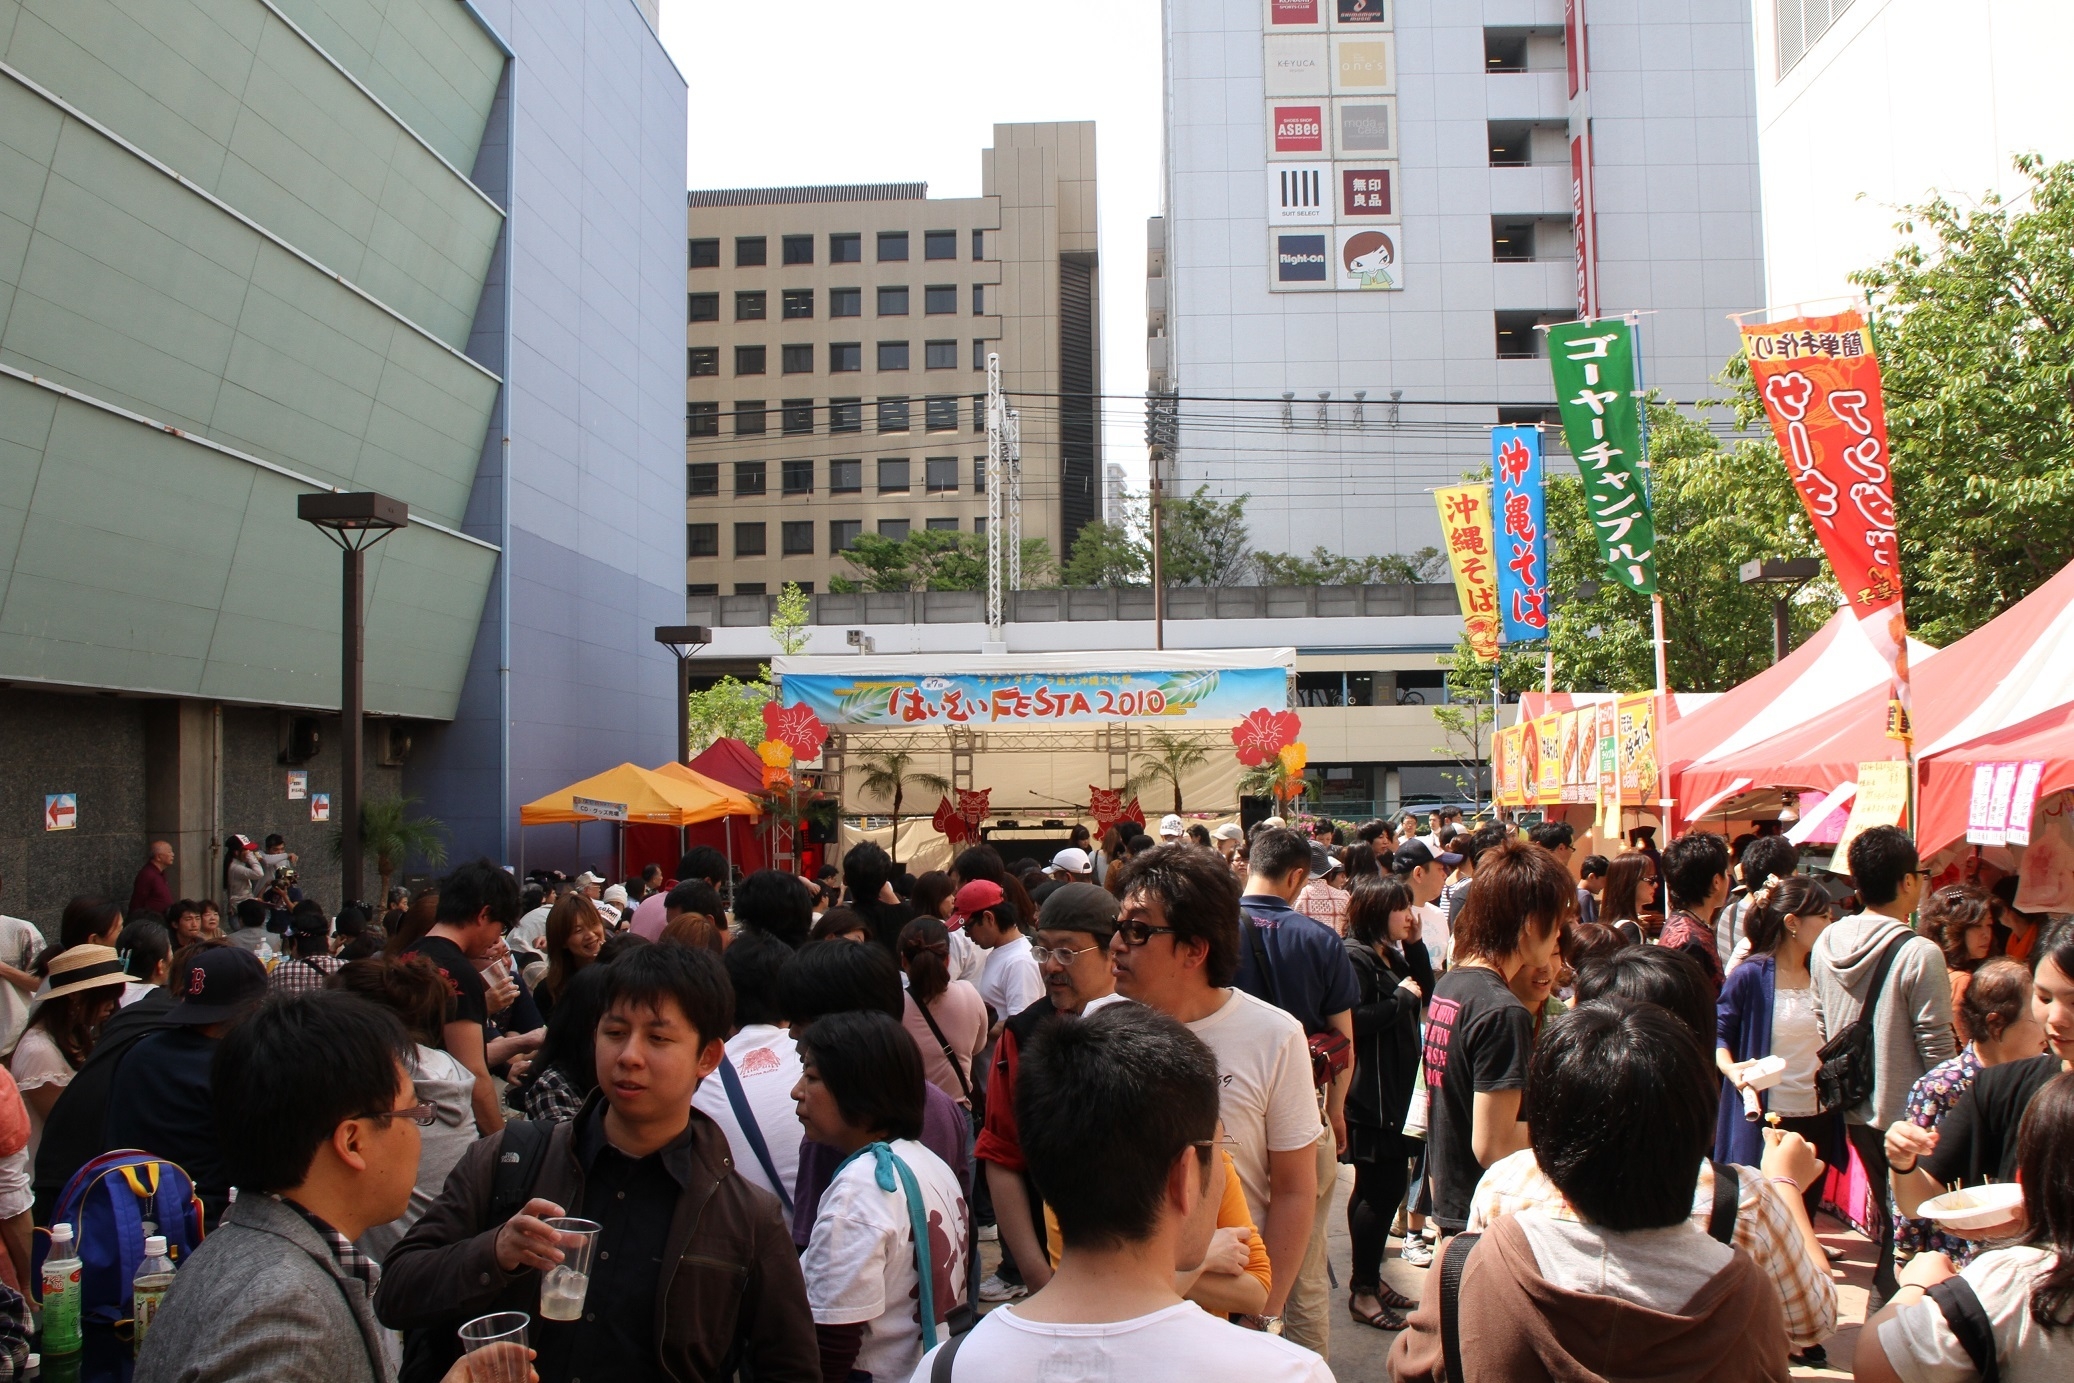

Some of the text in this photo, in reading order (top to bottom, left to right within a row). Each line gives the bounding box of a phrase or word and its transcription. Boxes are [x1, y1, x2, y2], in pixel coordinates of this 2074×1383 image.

[1277, 60, 1315, 68] KEYUCA
[1342, 60, 1384, 71] one's
[1278, 123, 1320, 136] ASBee
[1353, 178, 1382, 192] 無印
[1353, 193, 1382, 207] 良品
[1279, 253, 1325, 265] Right-on
[1563, 333, 1652, 587] ゴーヤーチャンプルー
[1498, 436, 1550, 630] 沖縄そば
[1444, 493, 1494, 613] 沖縄そば
[1095, 688, 1168, 717] 2010
[189, 967, 206, 994] B
